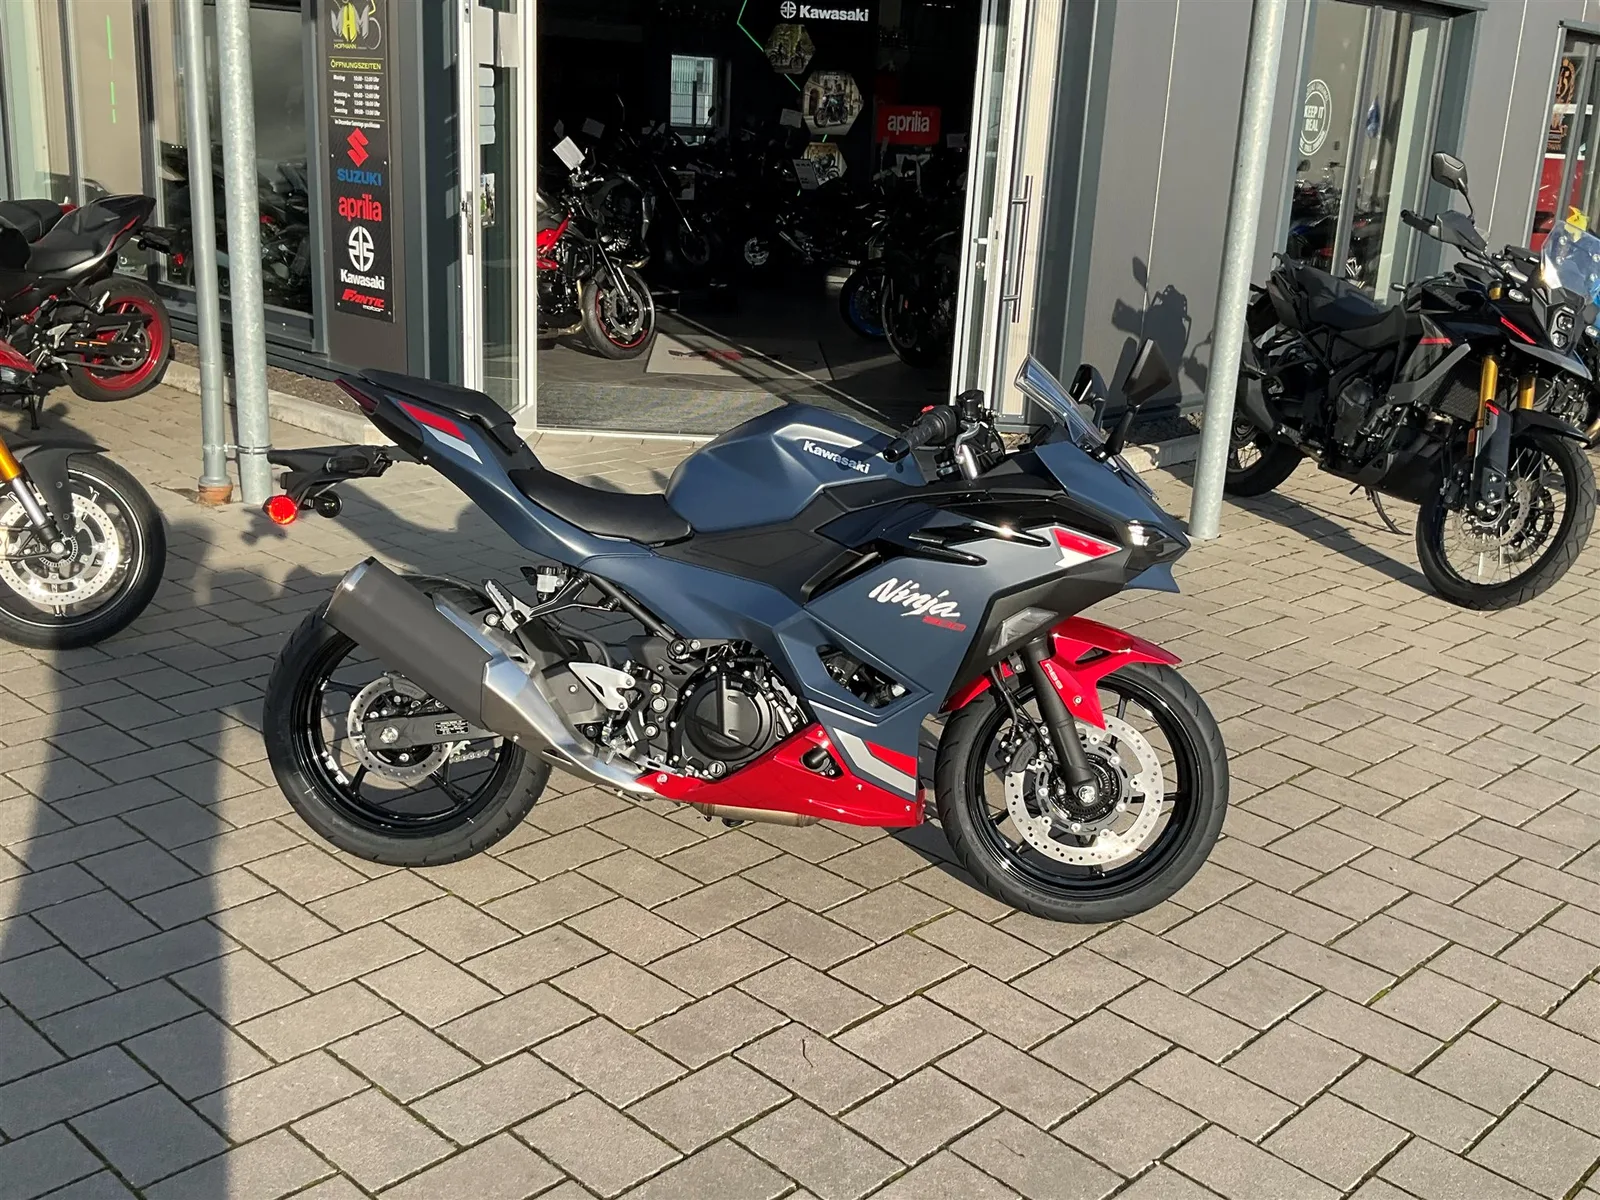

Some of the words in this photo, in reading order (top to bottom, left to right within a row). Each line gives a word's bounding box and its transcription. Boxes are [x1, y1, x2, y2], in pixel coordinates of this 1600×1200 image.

[800, 5, 869, 22] Kawasaki
[331, 59, 381, 69] ÖFFNUNGSZEITEN
[1304, 105, 1319, 119] KEEP
[1318, 106, 1325, 119] IT
[887, 110, 930, 136] aprilia
[1305, 119, 1319, 132] REAL
[337, 168, 382, 186] SUZUKI
[338, 193, 382, 222] aprilia
[340, 268, 385, 290] Kawasaki
[341, 288, 385, 308] FANTIC
[803, 440, 871, 474] Kawasaki
[868, 577, 961, 618] Ninja
